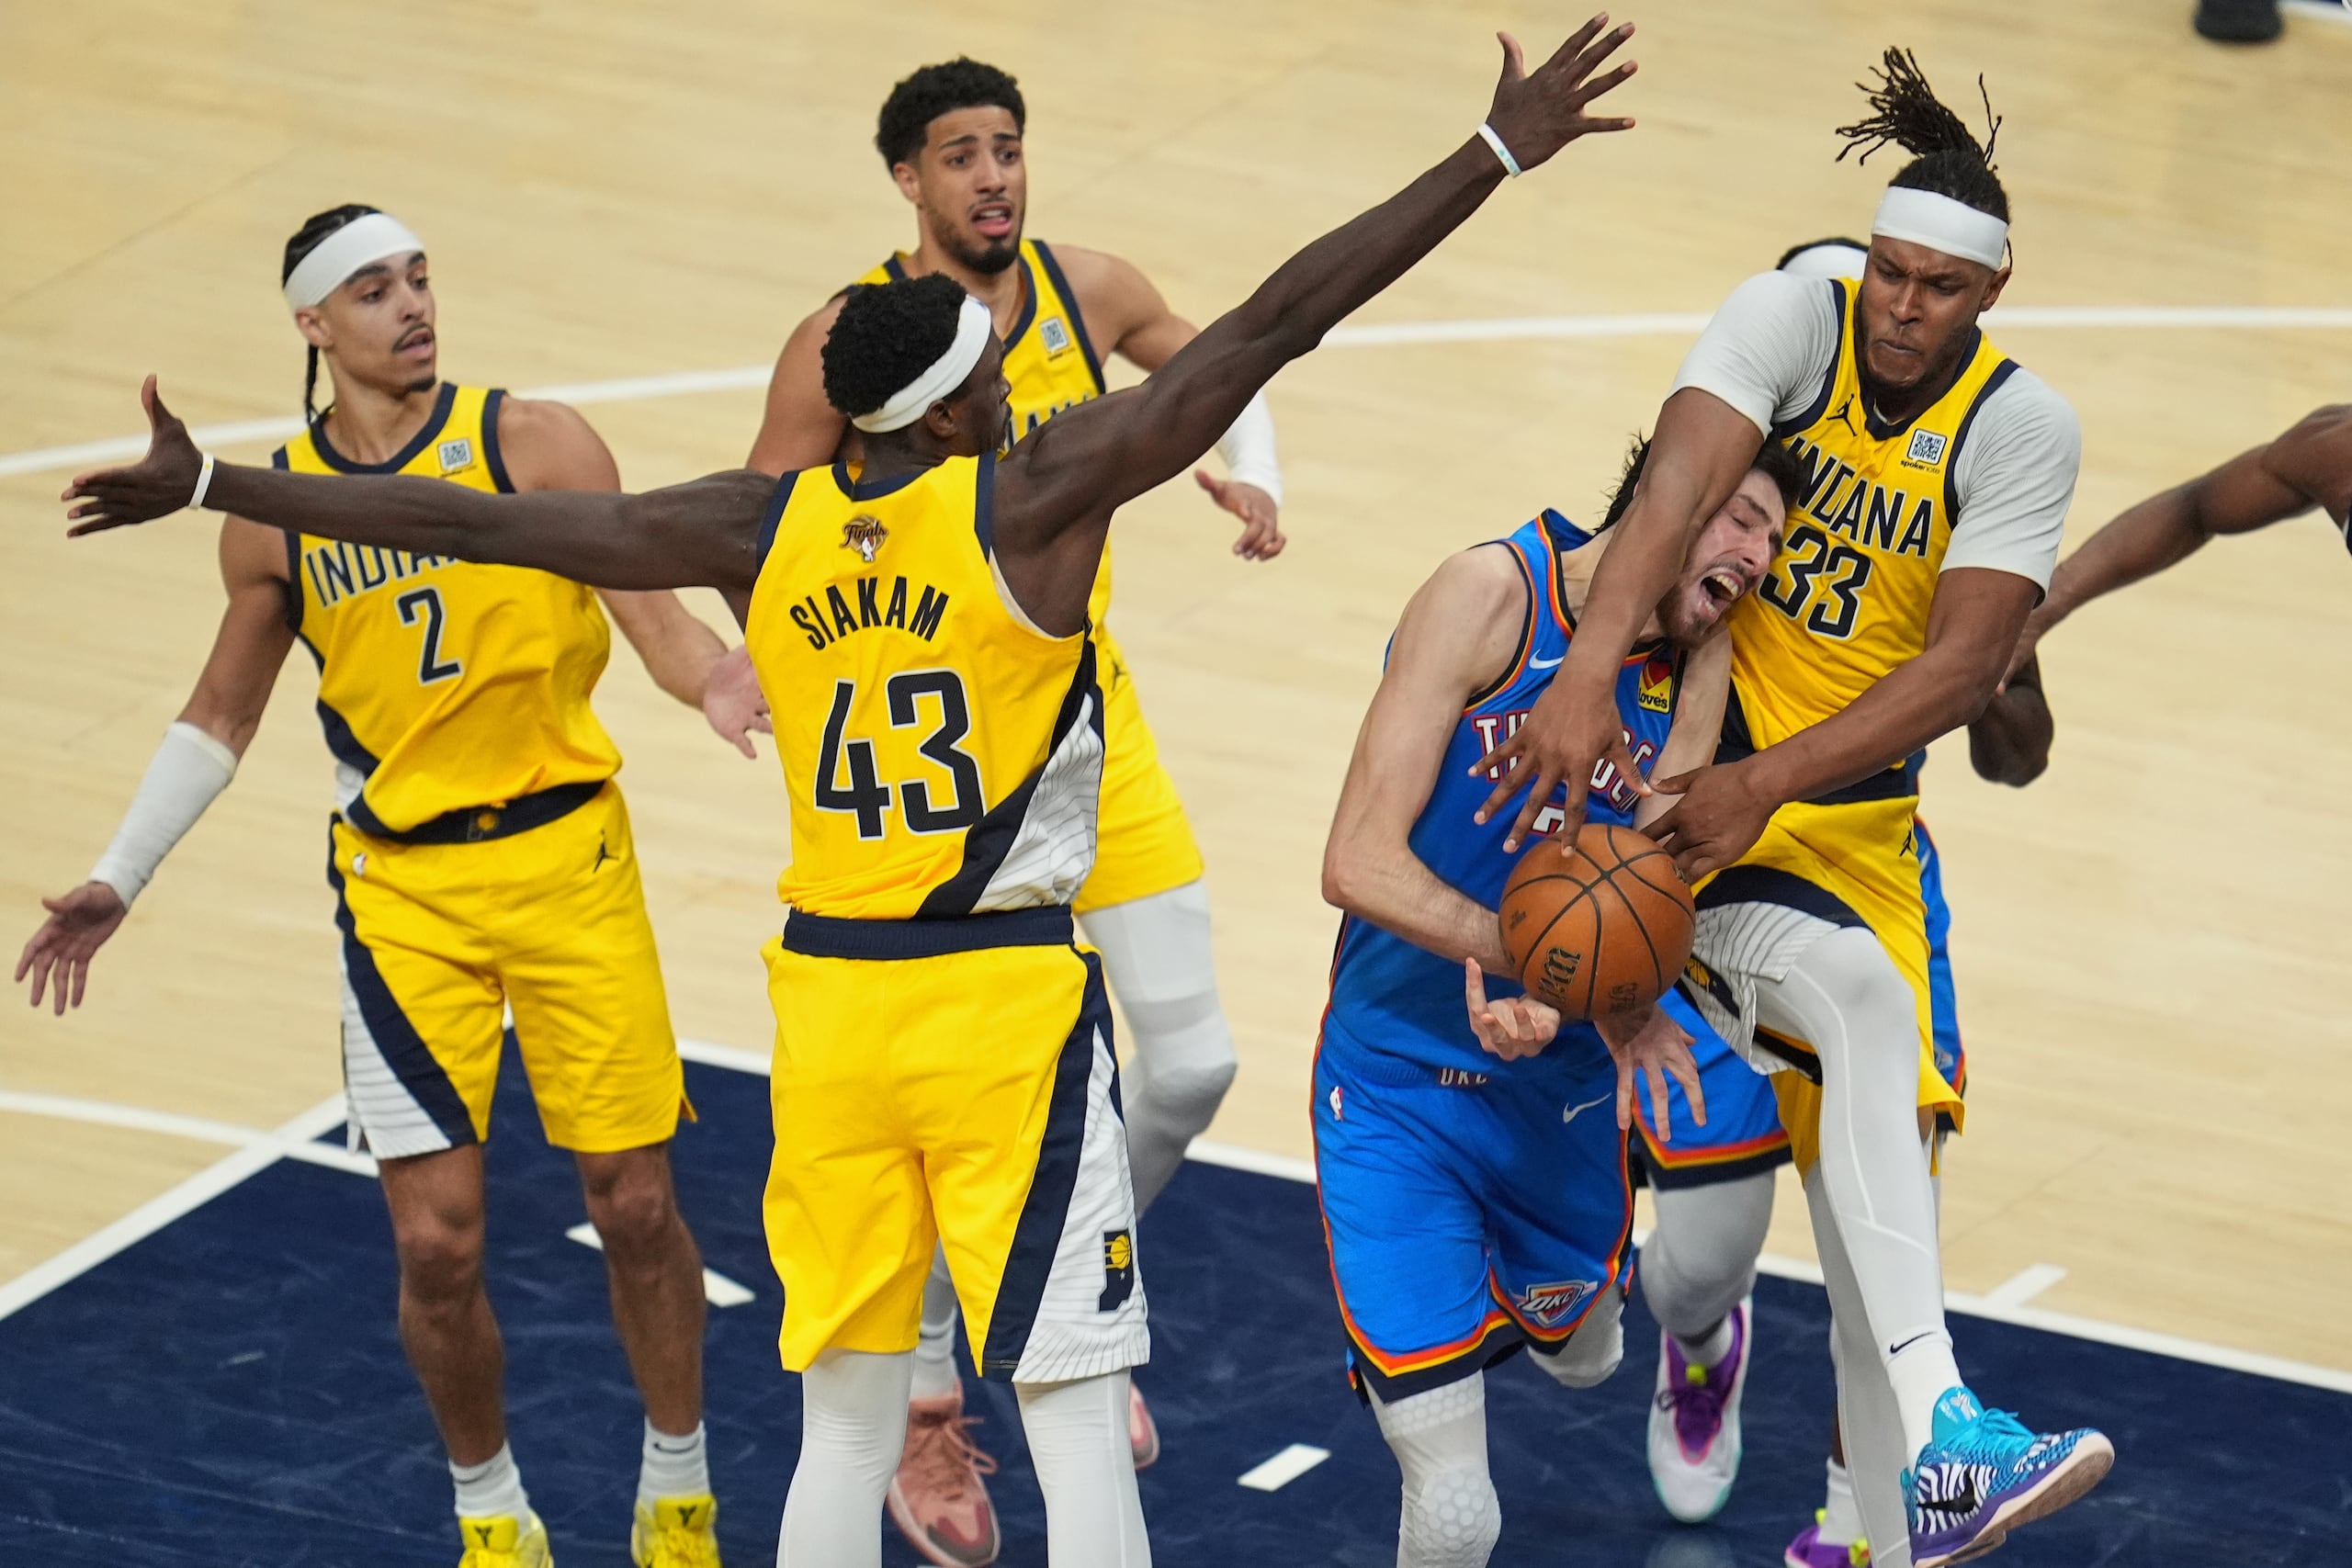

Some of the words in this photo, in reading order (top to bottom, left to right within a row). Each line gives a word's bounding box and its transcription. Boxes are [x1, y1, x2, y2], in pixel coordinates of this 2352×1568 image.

[838, 520, 888, 548] Finals
[1758, 525, 1872, 638] 33
[395, 584, 463, 686] 2
[790, 576, 949, 650] SIAKAM
[814, 667, 985, 841] 43
